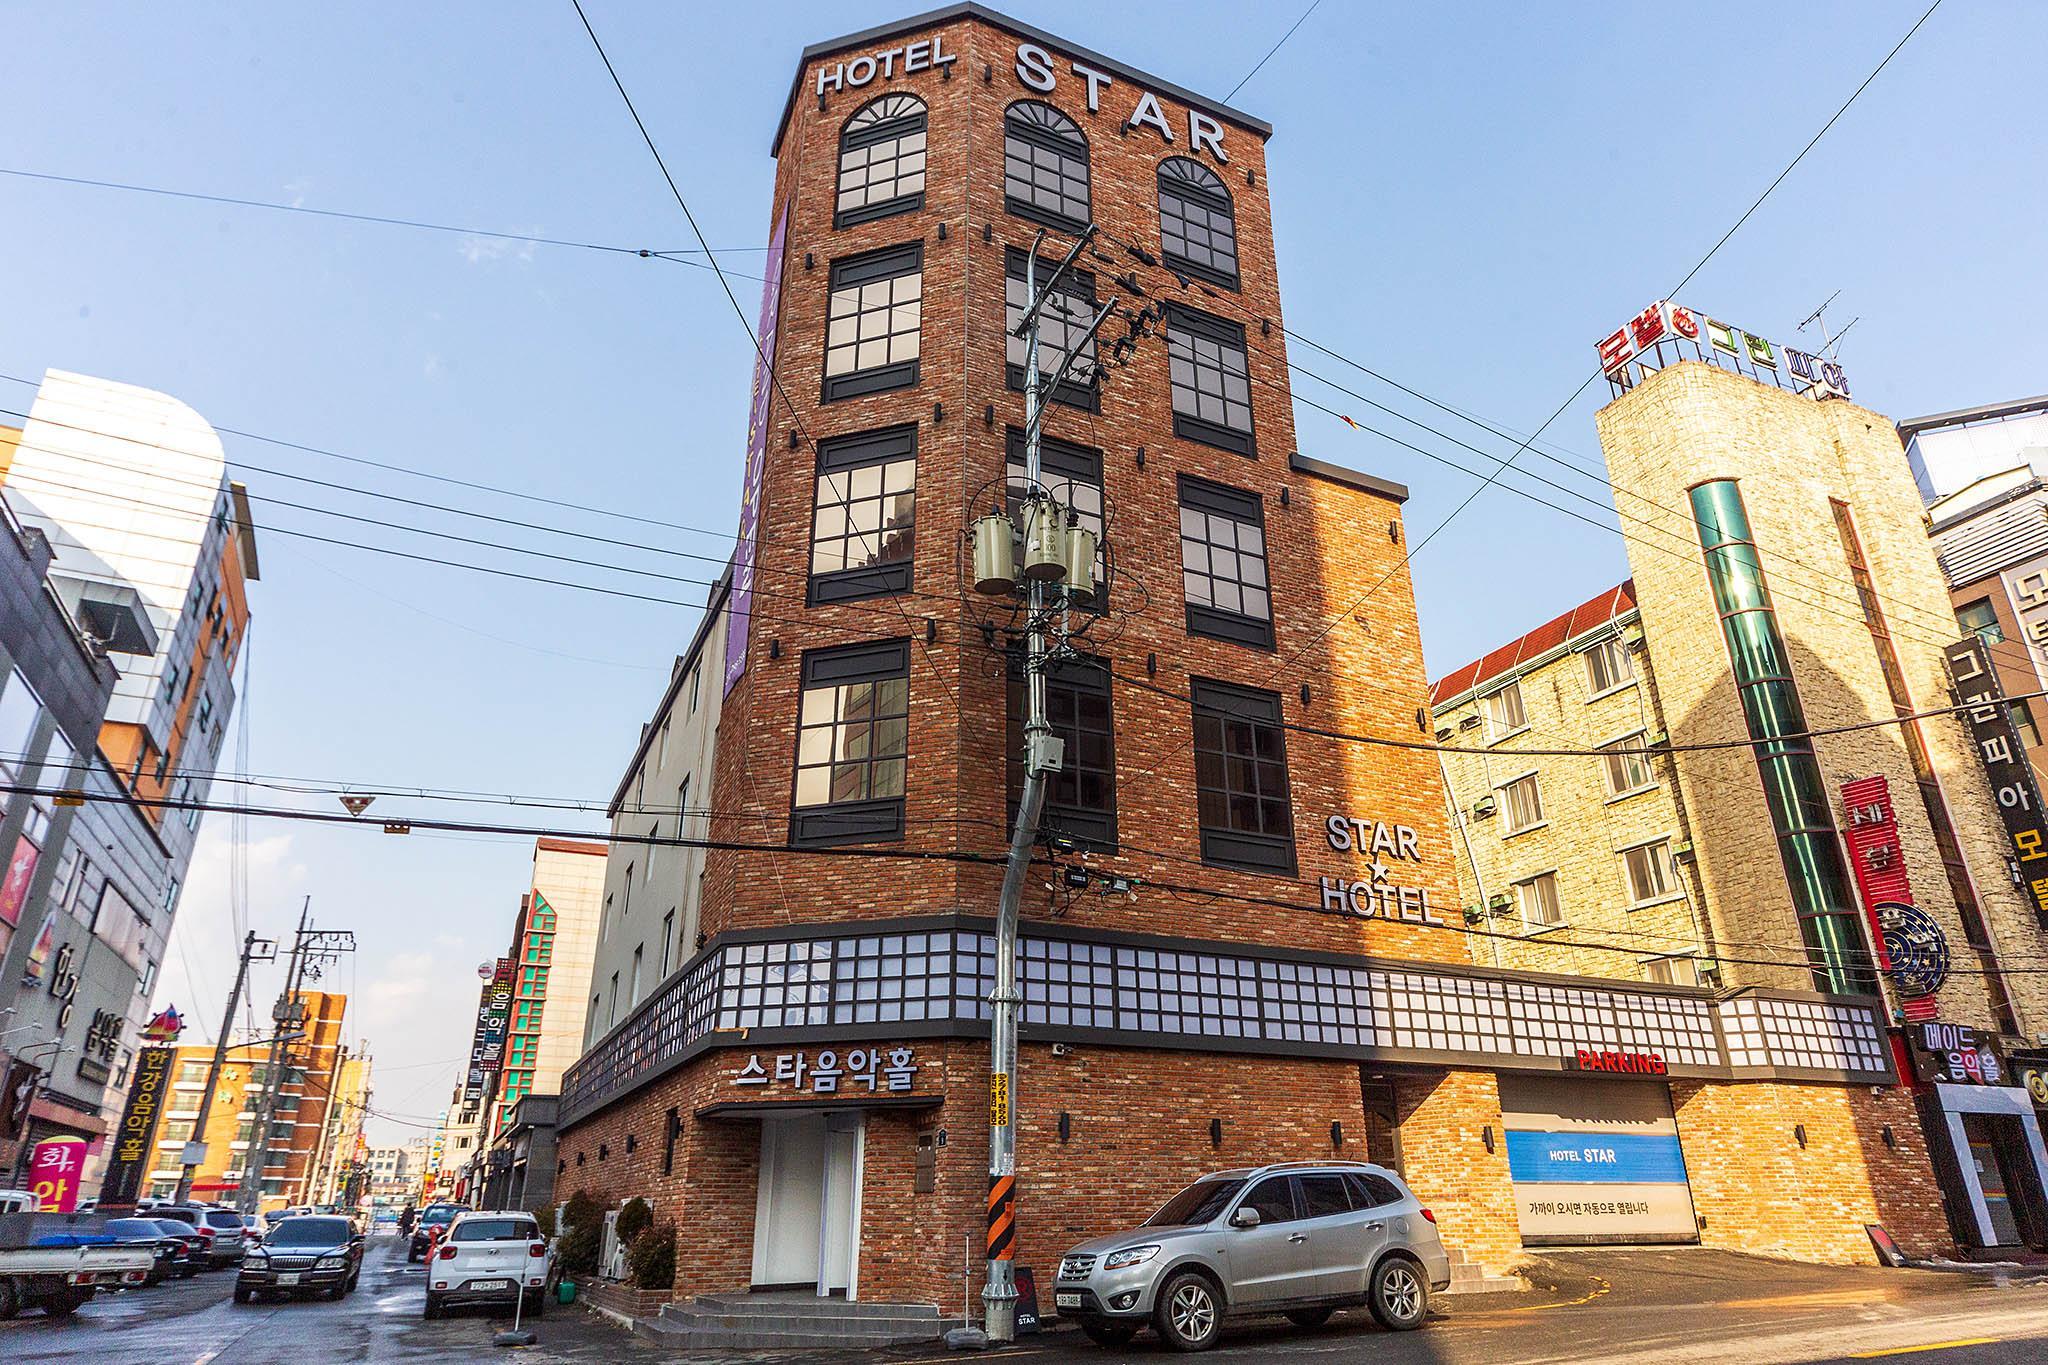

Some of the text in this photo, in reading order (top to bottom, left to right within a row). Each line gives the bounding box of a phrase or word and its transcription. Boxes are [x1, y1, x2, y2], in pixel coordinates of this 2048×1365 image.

[816, 36, 1229, 164] HOTEL STAR
[1706, 319, 1851, 396] 그린피아
[739, 446, 763, 600] OPEN
[1951, 649, 2031, 812] 그린피아
[1326, 814, 1422, 863] STAR
[1318, 876, 1444, 924] HOTEL
[482, 993, 509, 1061] 음악홀
[1924, 1023, 1976, 1052] 메이드
[736, 1047, 918, 1093] 스타음악홀
[1576, 1049, 1666, 1074] PARKING
[1949, 1051, 2000, 1082] 음악홀
[119, 1051, 168, 1161] 한강음악홀
[1550, 1148, 1617, 1163] HOTEL STAR
[1529, 1201, 1649, 1216] 가까이 오시면 자동으로 열립니다
[1018, 1317, 1036, 1325] STAR
